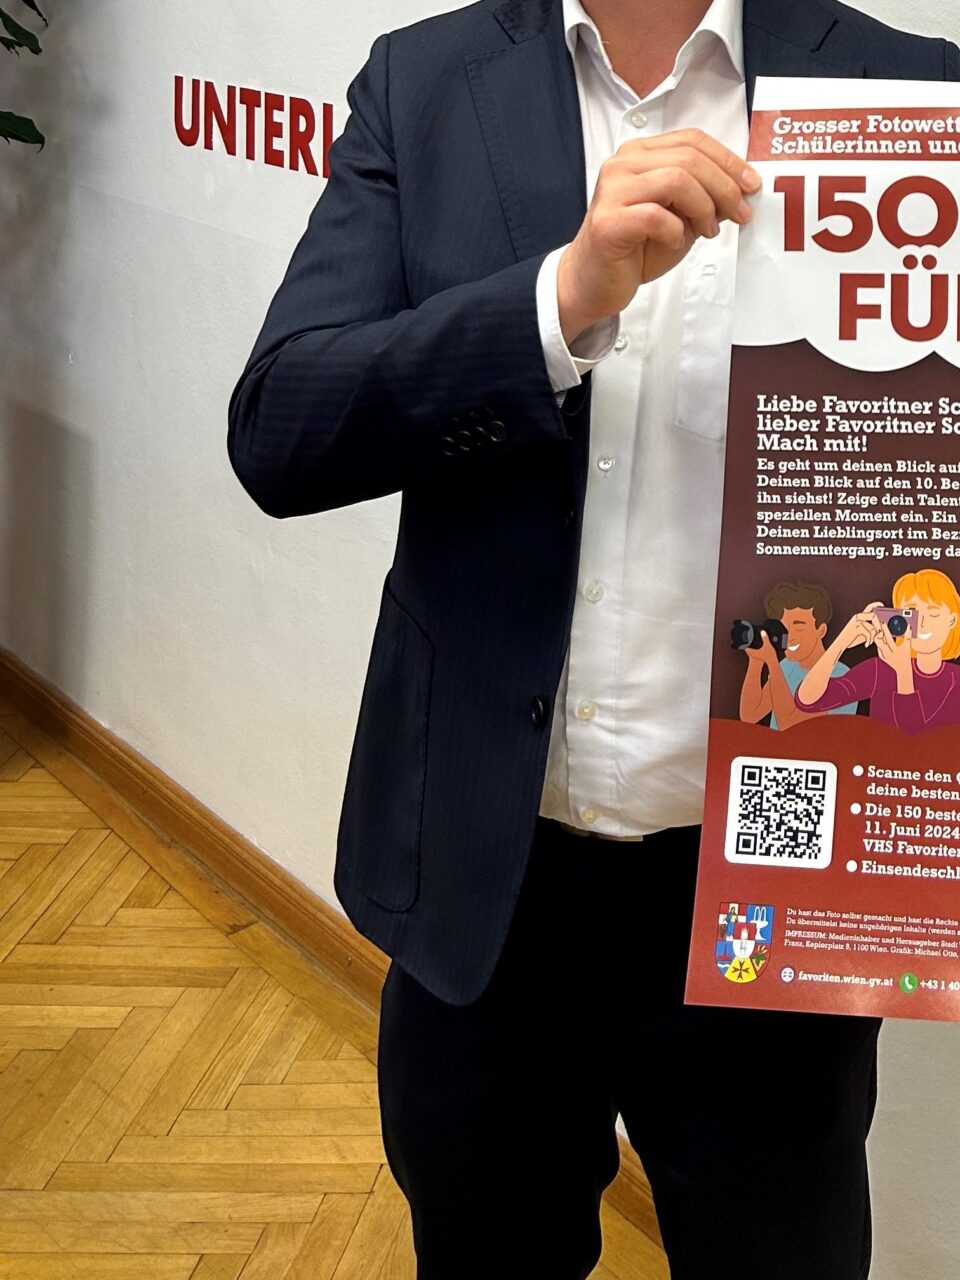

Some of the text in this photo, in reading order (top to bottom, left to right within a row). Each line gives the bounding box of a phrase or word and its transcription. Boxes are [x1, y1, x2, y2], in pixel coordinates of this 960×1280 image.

[772, 116, 861, 134] Grosser
[770, 135, 922, 154] Schülerinnen
[774, 175, 959, 253] 150
[756, 394, 817, 412] Liebe
[822, 395, 933, 414] Favoritner
[756, 414, 820, 432] lieber
[825, 415, 936, 434] Favoritner
[756, 433, 867, 452] Mach mit!
[756, 457, 775, 470] Es
[778, 458, 810, 473] geht
[813, 461, 838, 471] um
[842, 459, 892, 472] deinen
[896, 459, 935, 473] Blick
[756, 474, 810, 487] Deinen
[813, 475, 853, 488] Blick
[856, 476, 881, 488] auf
[883, 476, 911, 489] den
[915, 477, 937, 489] 10.
[756, 491, 781, 503] ihn
[784, 492, 832, 504] siehst!
[837, 492, 878, 508] Zeige
[881, 493, 914, 505] dein
[756, 508, 831, 523] speziellen
[834, 509, 897, 522] Moment
[900, 510, 928, 522] ein.
[931, 510, 957, 523] Ein
[756, 525, 810, 538] Deinen
[813, 526, 903, 542] Lieblingsort
[906, 527, 928, 539] im
[756, 542, 888, 559] Sonnenuntergang.
[892, 543, 942, 560] Beweg
[867, 765, 921, 780] Scanne
[924, 769, 952, 782] den
[866, 782, 907, 797] deine
[911, 785, 960, 800] besten
[864, 802, 891, 817] Die
[895, 805, 921, 818] 150
[865, 820, 886, 834] 11.
[889, 822, 920, 838] Juni
[924, 824, 960, 839] 2024
[862, 838, 893, 853] VHS
[798, 970, 893, 988] favoriten.wien.gv.at
[919, 980, 938, 989] +43
[940, 981, 945, 990] 1
